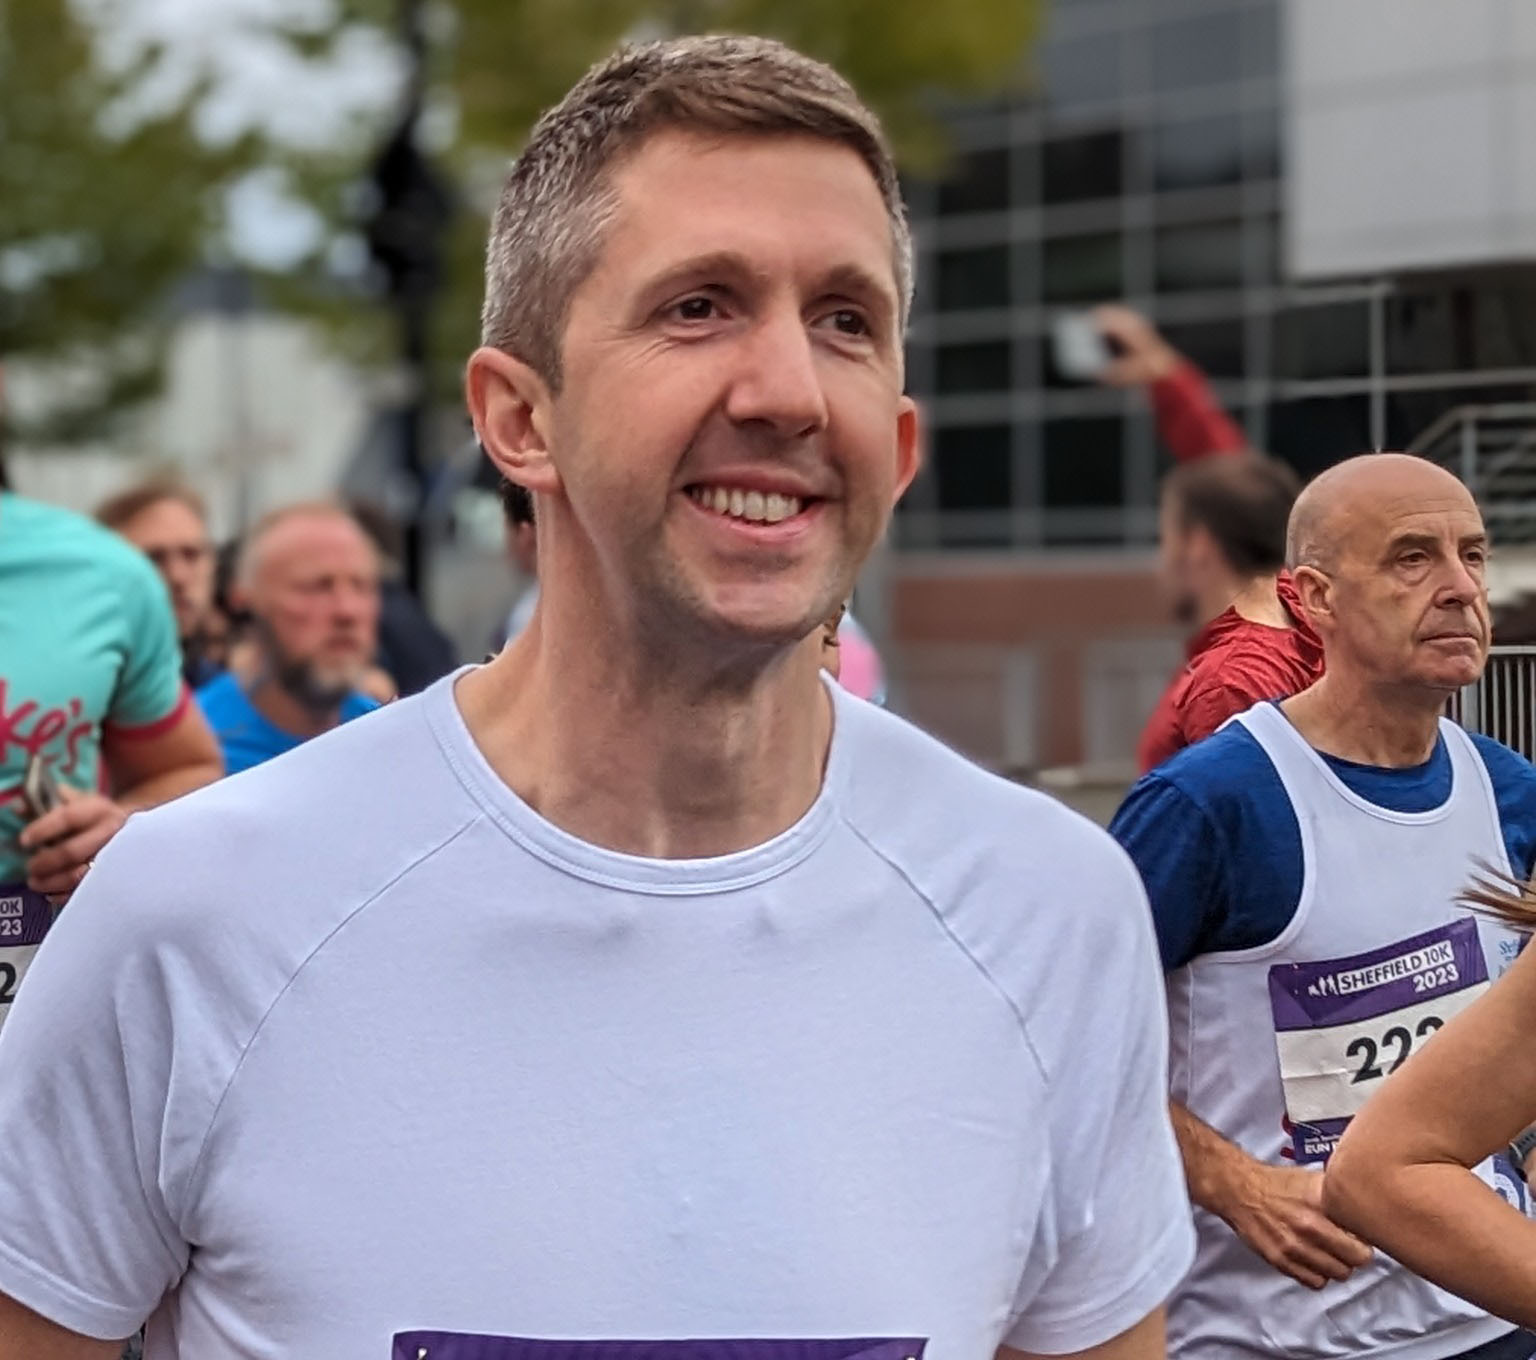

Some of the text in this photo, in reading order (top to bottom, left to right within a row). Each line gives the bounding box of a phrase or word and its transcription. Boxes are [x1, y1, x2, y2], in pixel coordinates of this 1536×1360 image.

[1340, 943, 1451, 991] SHEFFIELD 10K
[1413, 963, 1459, 993] 2023
